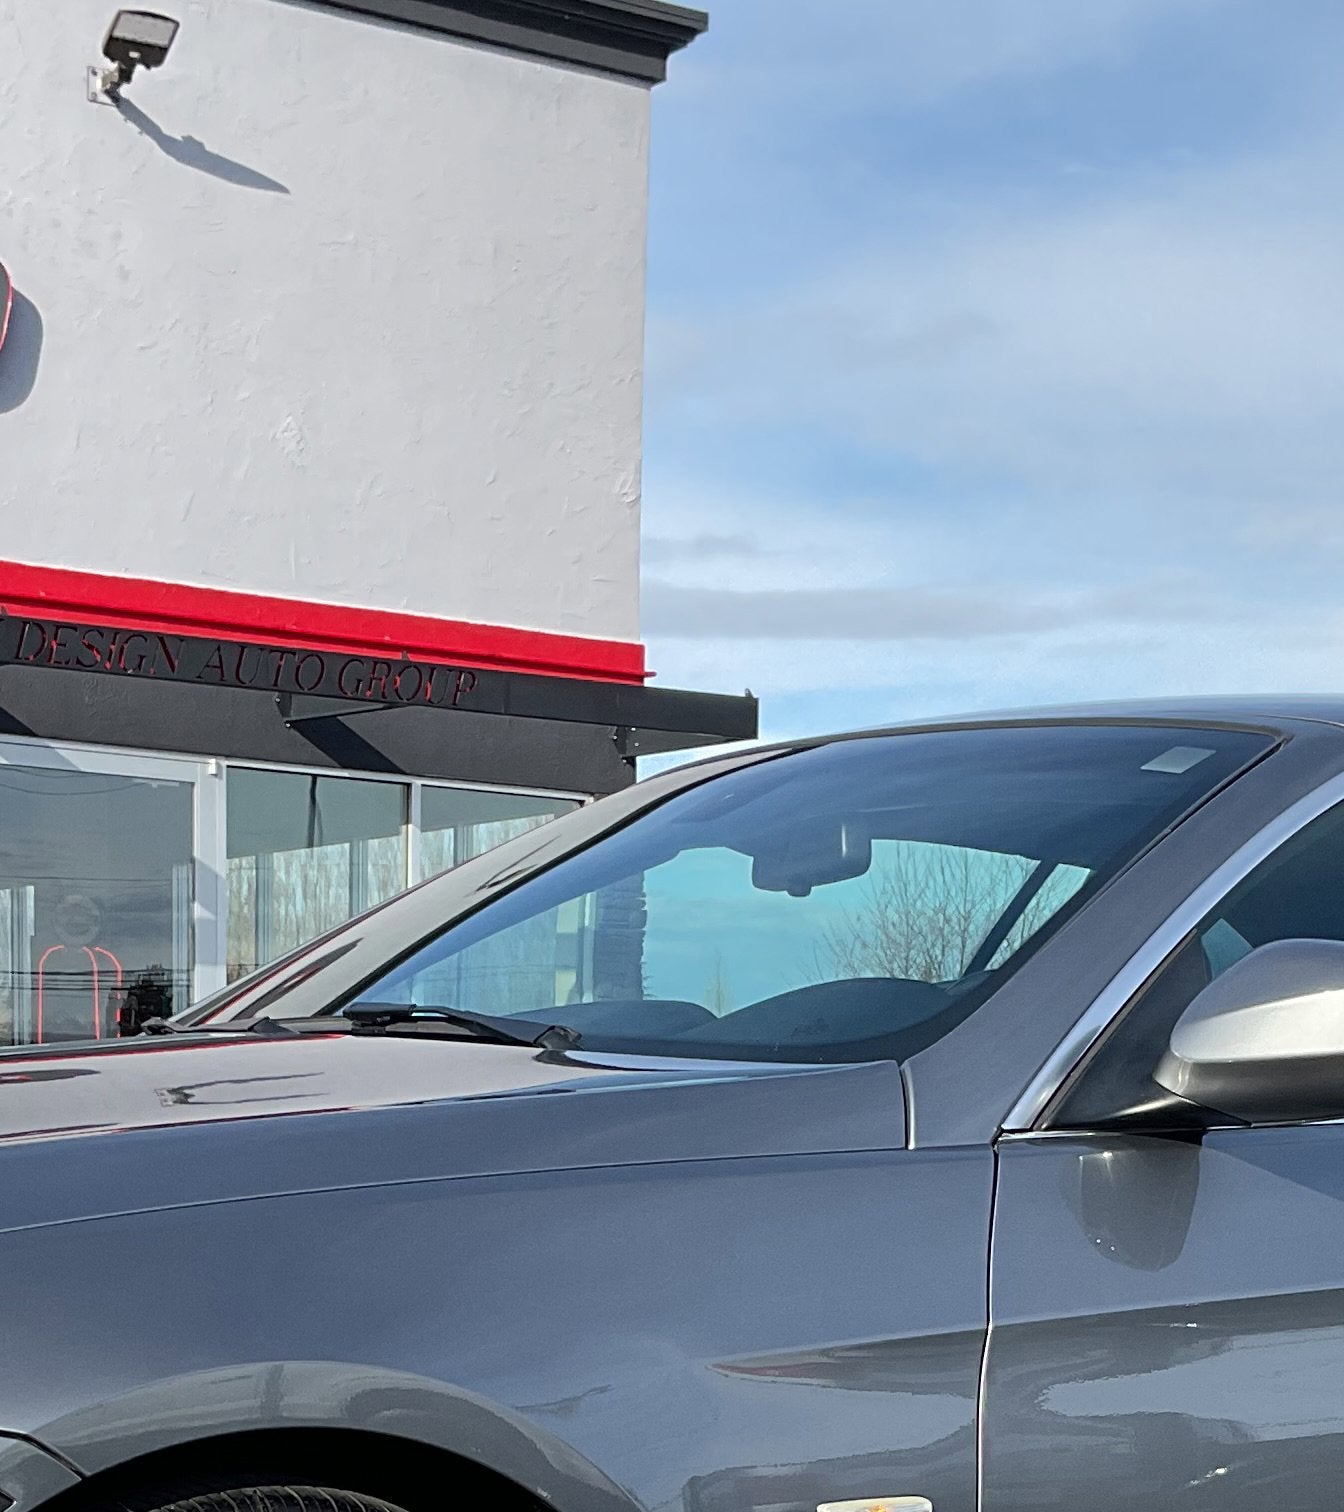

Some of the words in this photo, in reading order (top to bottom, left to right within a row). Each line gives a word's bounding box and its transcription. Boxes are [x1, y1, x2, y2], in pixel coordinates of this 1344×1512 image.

[14, 620, 186, 676] DESIGN
[196, 643, 326, 692] AUTO
[338, 658, 478, 705] GROUP
